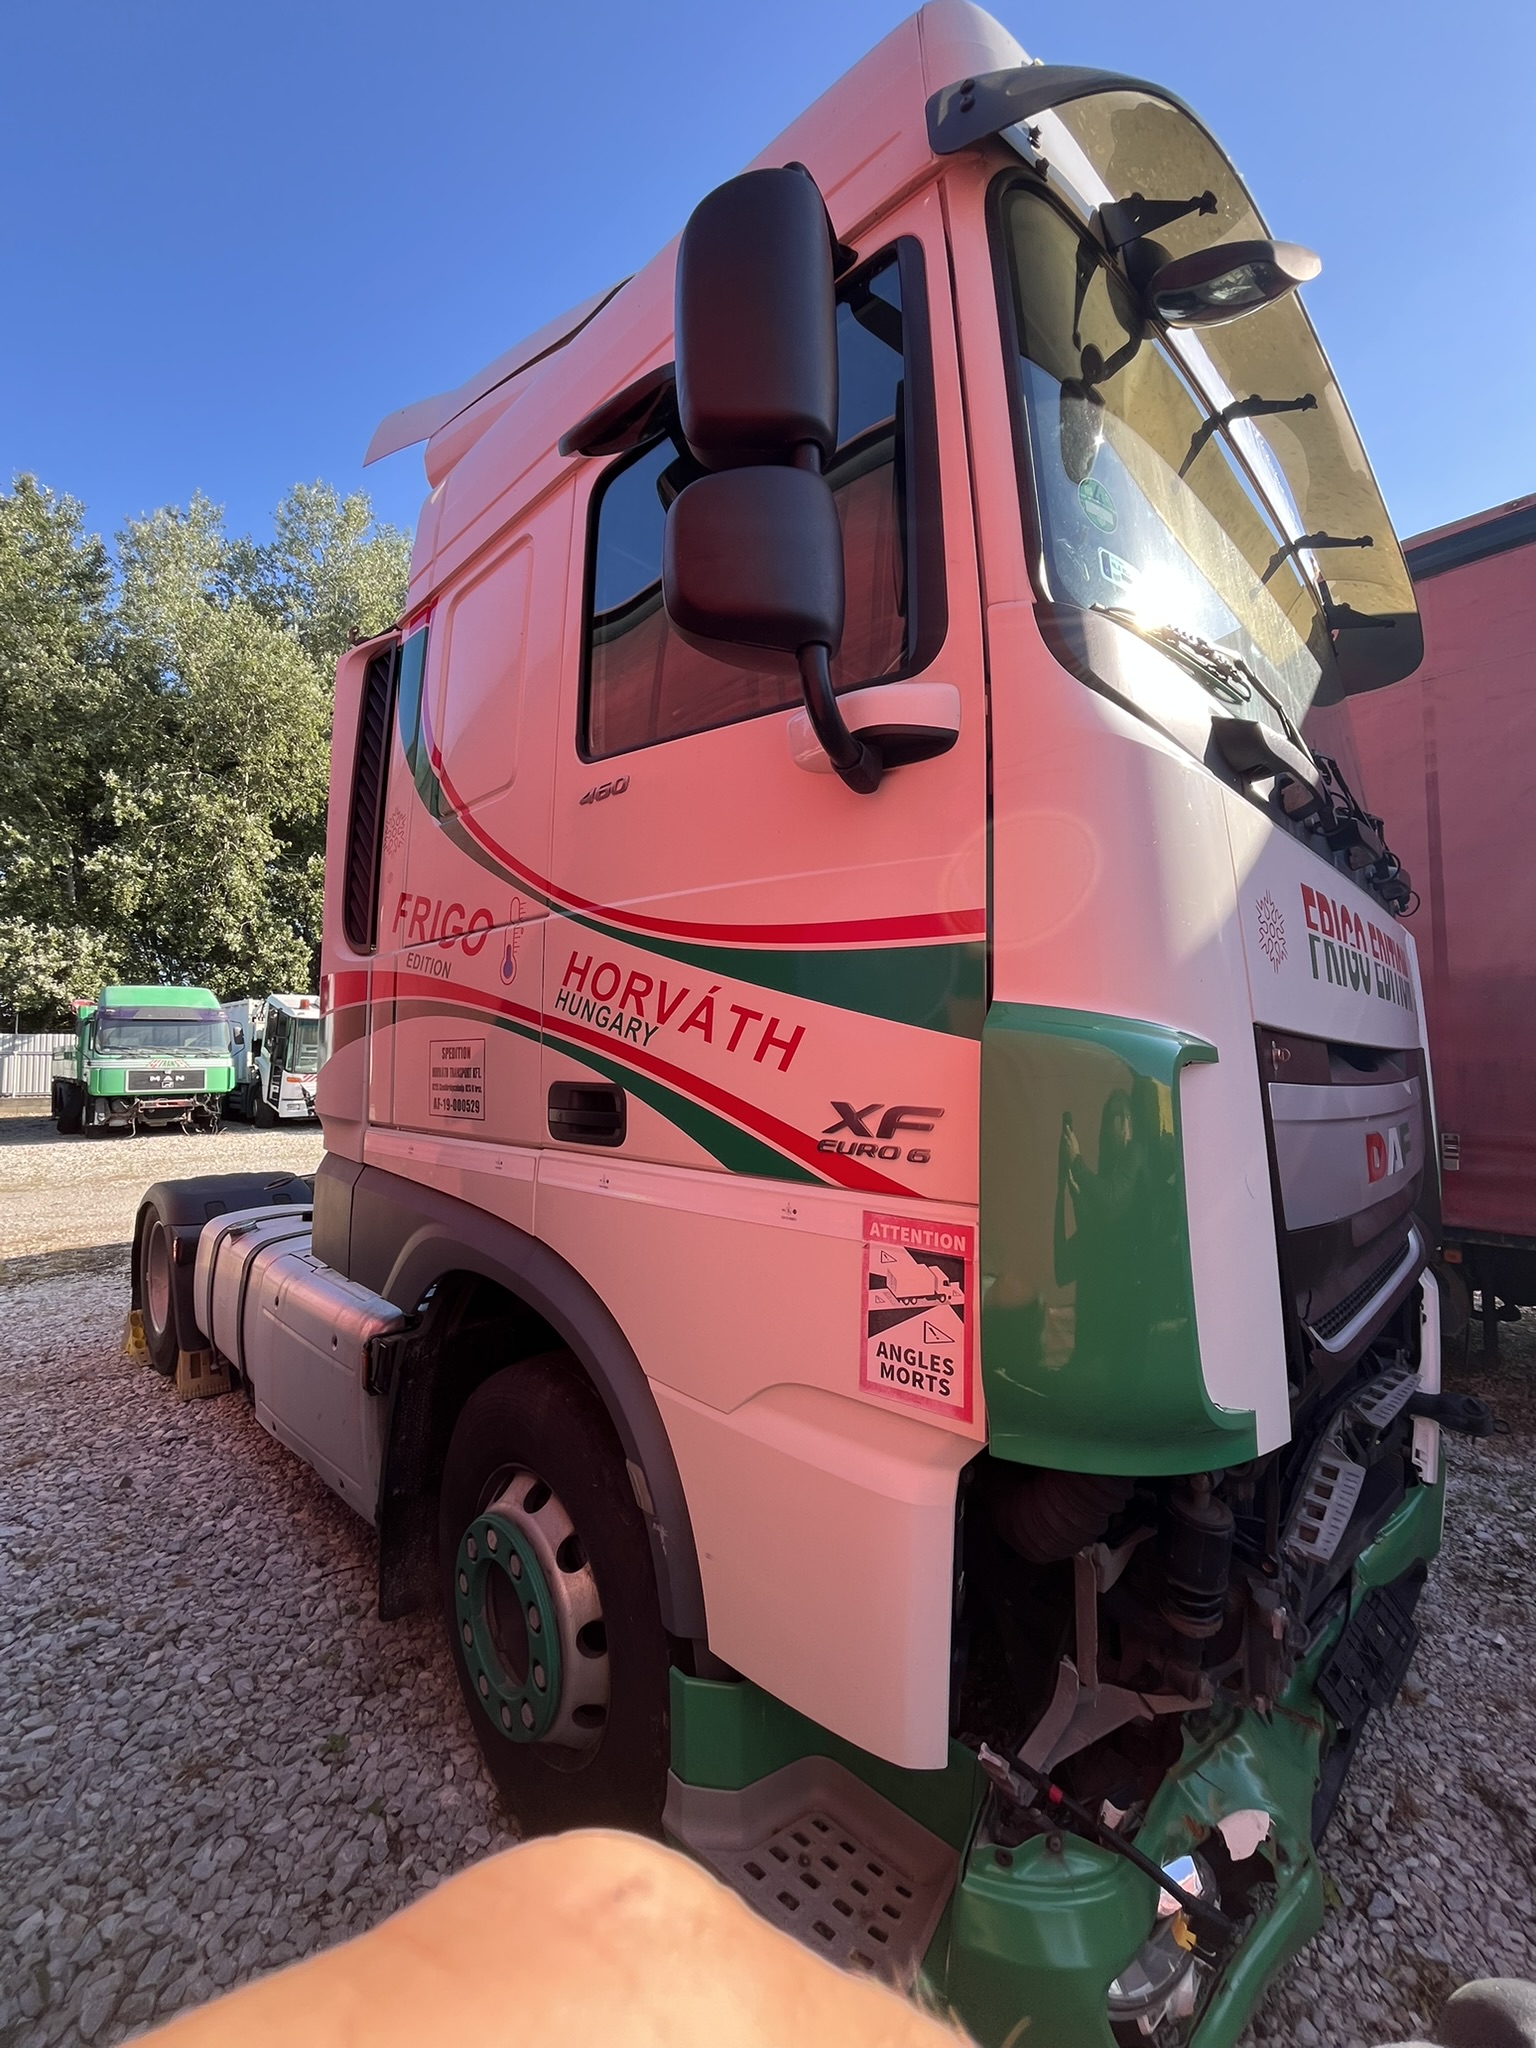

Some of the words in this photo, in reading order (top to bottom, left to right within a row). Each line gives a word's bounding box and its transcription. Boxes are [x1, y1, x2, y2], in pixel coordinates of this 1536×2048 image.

[579, 776, 630, 805] 460
[392, 892, 494, 956] FRIGO
[406, 952, 451, 979] EDITION
[555, 988, 659, 1047] HUNGARY
[562, 951, 806, 1072] HORVÁTH
[442, 1046, 471, 1060] SPEDITION
[822, 1101, 945, 1140] XF
[817, 1139, 902, 1161] EURO
[906, 1148, 931, 1164] 6
[1365, 1122, 1411, 1184] DAF
[869, 1222, 966, 1252] ATTENTION
[876, 1341, 955, 1377] ANGLES
[880, 1361, 951, 1397] MORTS
